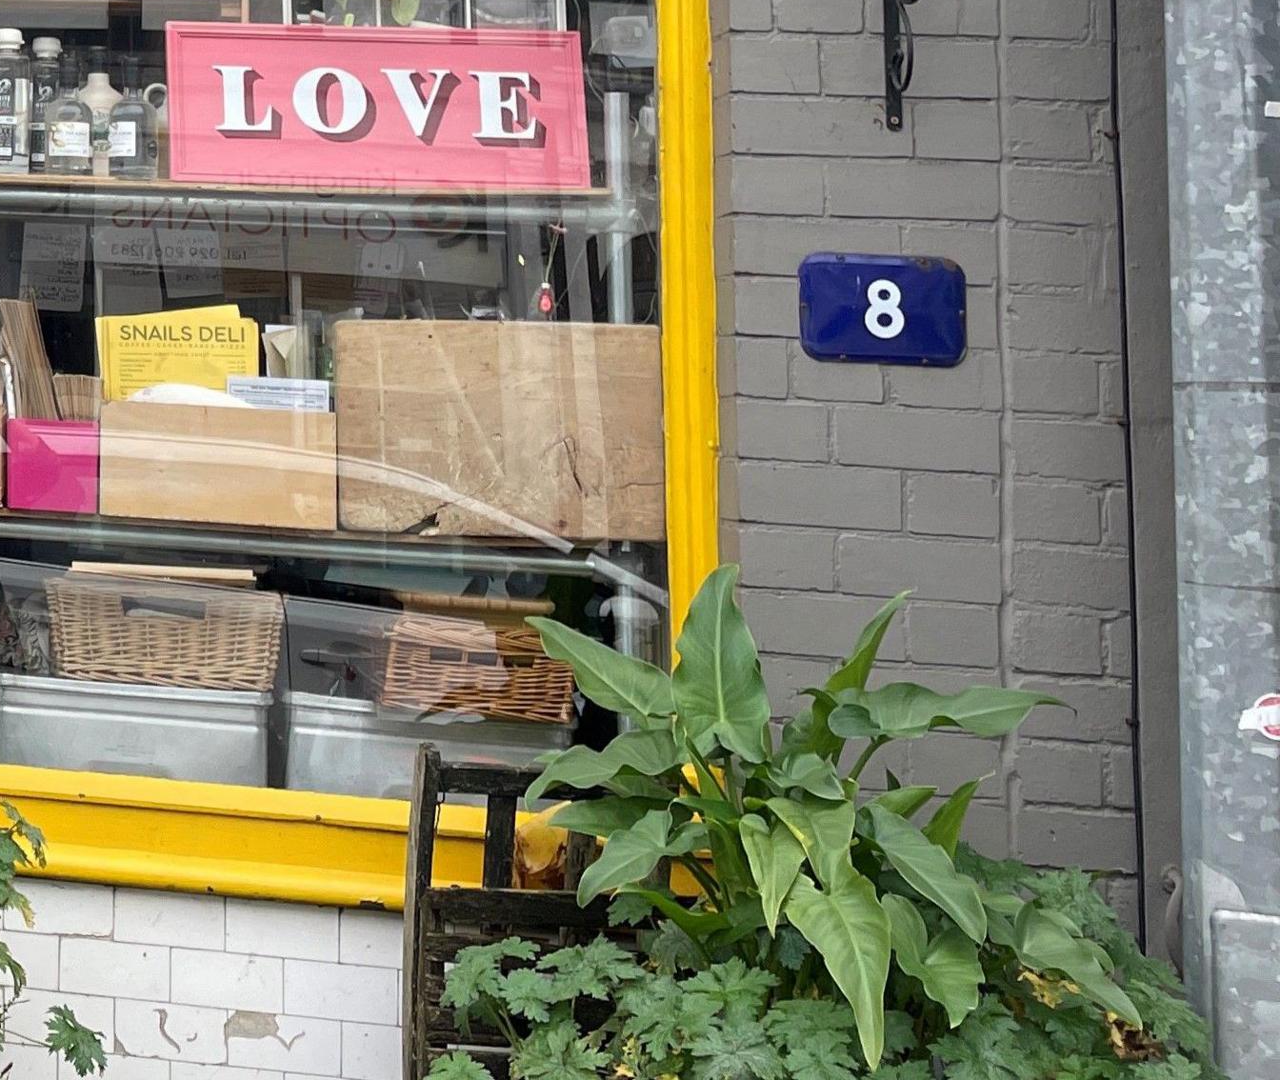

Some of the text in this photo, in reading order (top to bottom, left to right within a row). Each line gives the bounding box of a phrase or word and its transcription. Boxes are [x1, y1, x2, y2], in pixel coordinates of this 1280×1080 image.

[211, 64, 546, 148] LOVE
[119, 325, 246, 343] SNAILS DELI
[863, 278, 906, 340] 8
